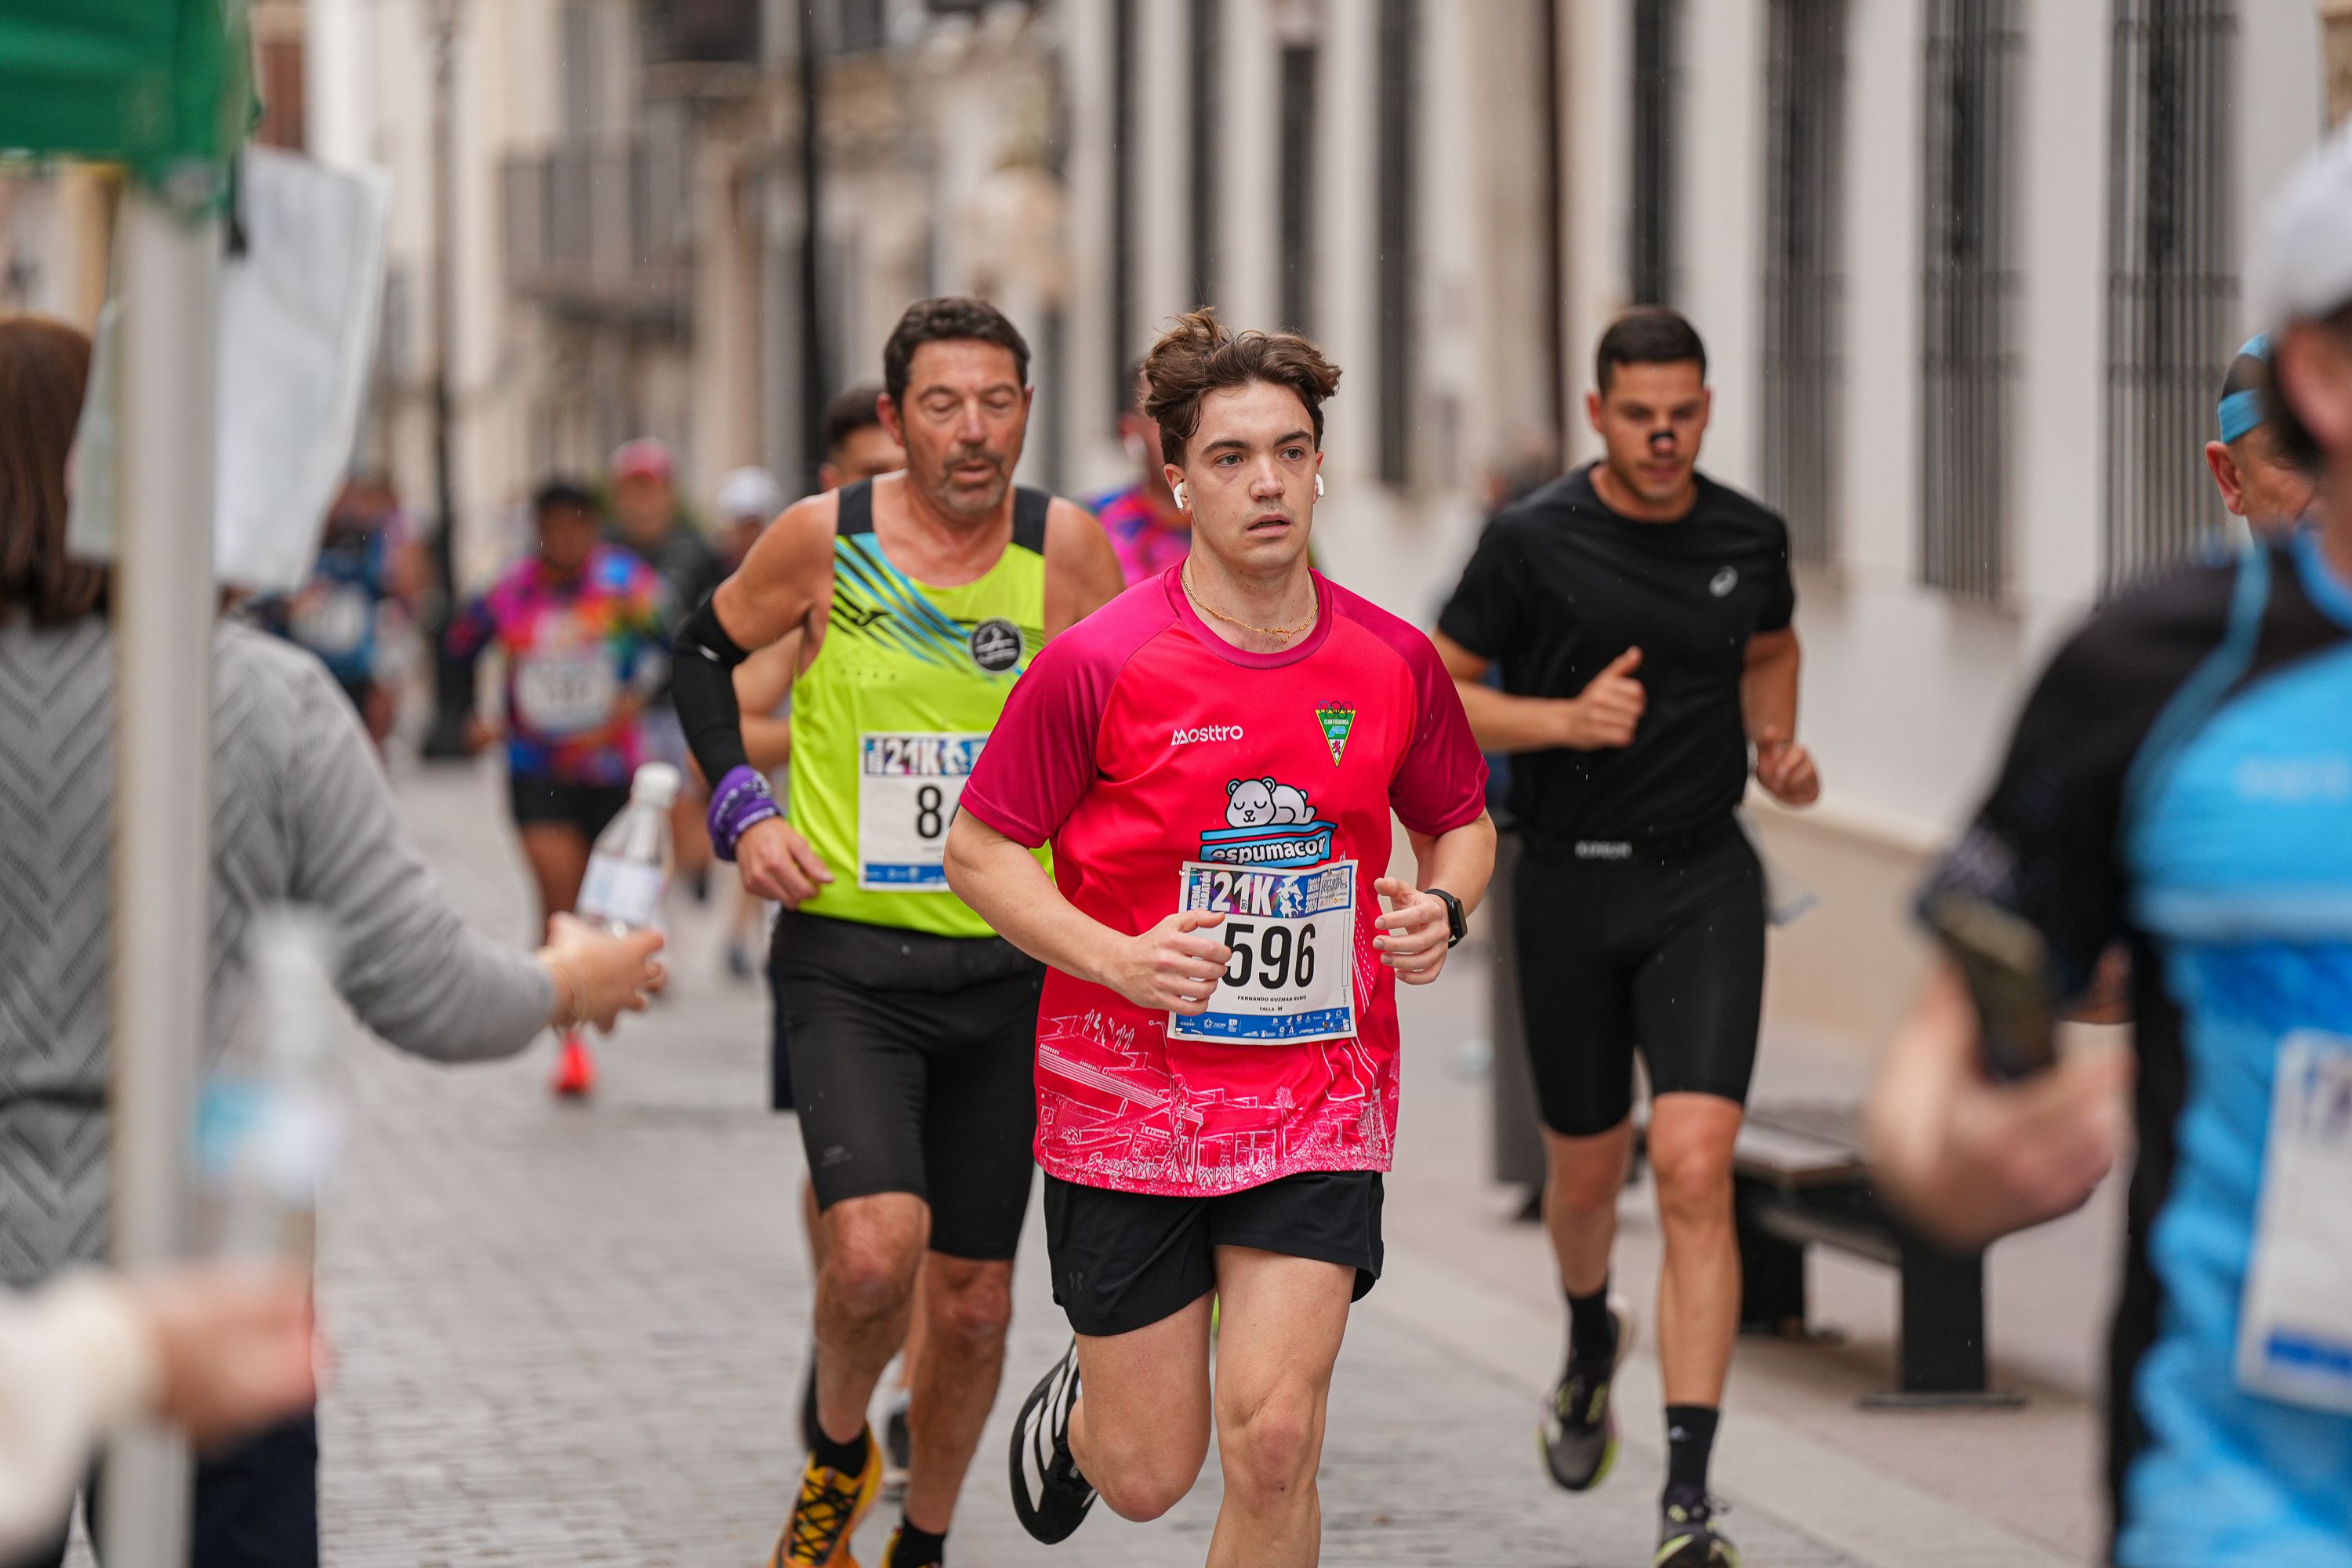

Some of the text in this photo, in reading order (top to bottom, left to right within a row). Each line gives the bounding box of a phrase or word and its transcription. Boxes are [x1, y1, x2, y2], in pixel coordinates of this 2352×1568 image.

[884, 737, 942, 774] 21K
[1171, 724, 1243, 746] Mosttro
[916, 786, 960, 838] 8
[1212, 836, 1327, 864] espumacor
[1211, 871, 1276, 916] 21K
[1221, 922, 1316, 989] 596
